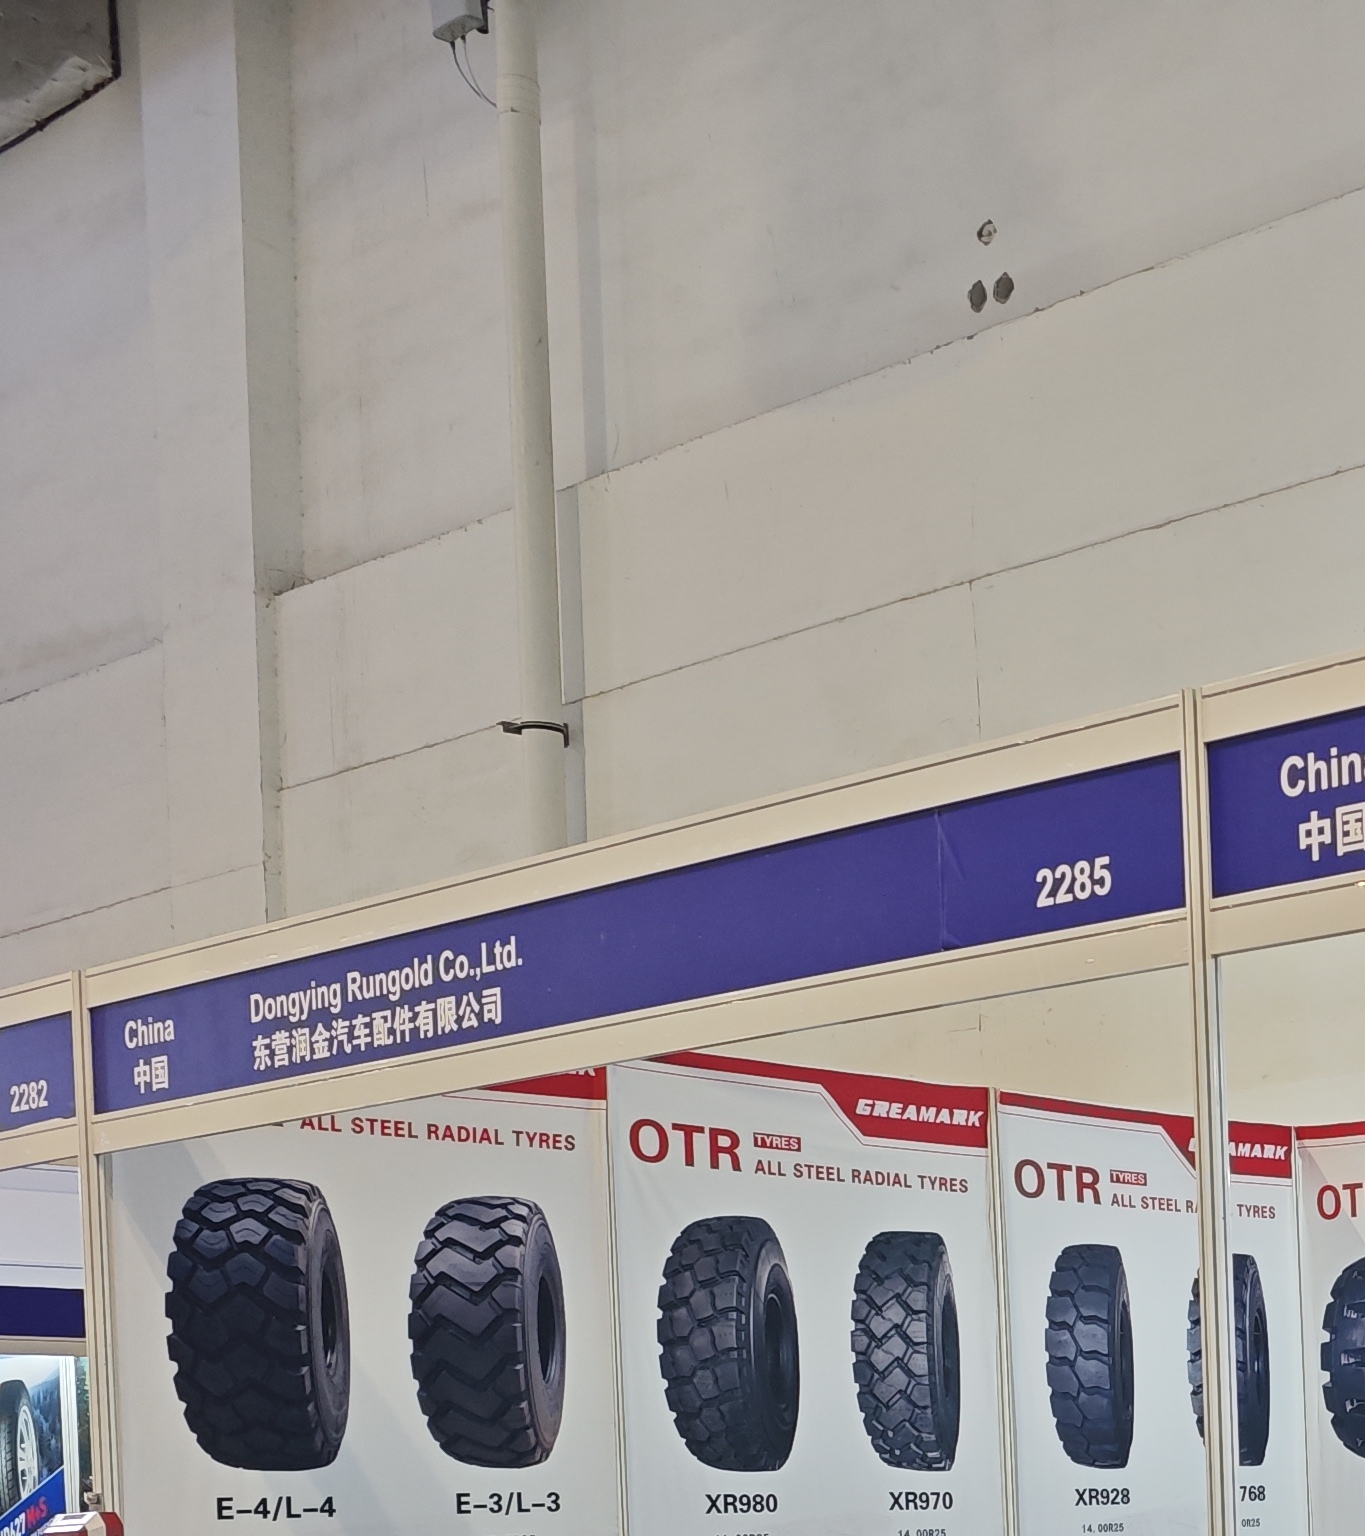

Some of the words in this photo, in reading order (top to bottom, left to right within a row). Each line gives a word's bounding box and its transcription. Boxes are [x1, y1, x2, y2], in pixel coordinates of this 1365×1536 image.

[1036, 856, 1111, 908] 2285
[250, 985, 342, 1027] Dongying
[347, 956, 432, 1004] Rungold
[439, 936, 523, 982] Co.,Ltd.
[125, 1016, 174, 1049] China
[253, 987, 502, 1072] 东营润金汽车配件有限公司
[133, 1056, 169, 1095] 中国
[10, 1082, 48, 1112] 2282
[856, 1098, 984, 1127] GREAMARK
[300, 1115, 342, 1132] ALL
[351, 1117, 418, 1139] STEEL
[427, 1124, 504, 1146] RADIAL
[512, 1130, 576, 1151] TYRES
[629, 1119, 742, 1173] OTR
[756, 1134, 799, 1150] TYRES
[754, 1159, 786, 1177] ALL
[793, 1163, 845, 1183] STEEL
[852, 1169, 912, 1189] RADIAL
[917, 1175, 969, 1194] TYRES
[1014, 1159, 1101, 1205] OTR
[1111, 1171, 1145, 1184] TYRES
[1111, 1193, 1136, 1208] ALL
[1141, 1196, 1181, 1212] STEEL
[1237, 1204, 1276, 1219] TYRES
[216, 1496, 336, 1521] E-4/L-4
[456, 1492, 561, 1515] E-3/L-3
[705, 1494, 778, 1514] XR980
[889, 1491, 953, 1511] XR970
[1075, 1488, 1130, 1506] XR928
